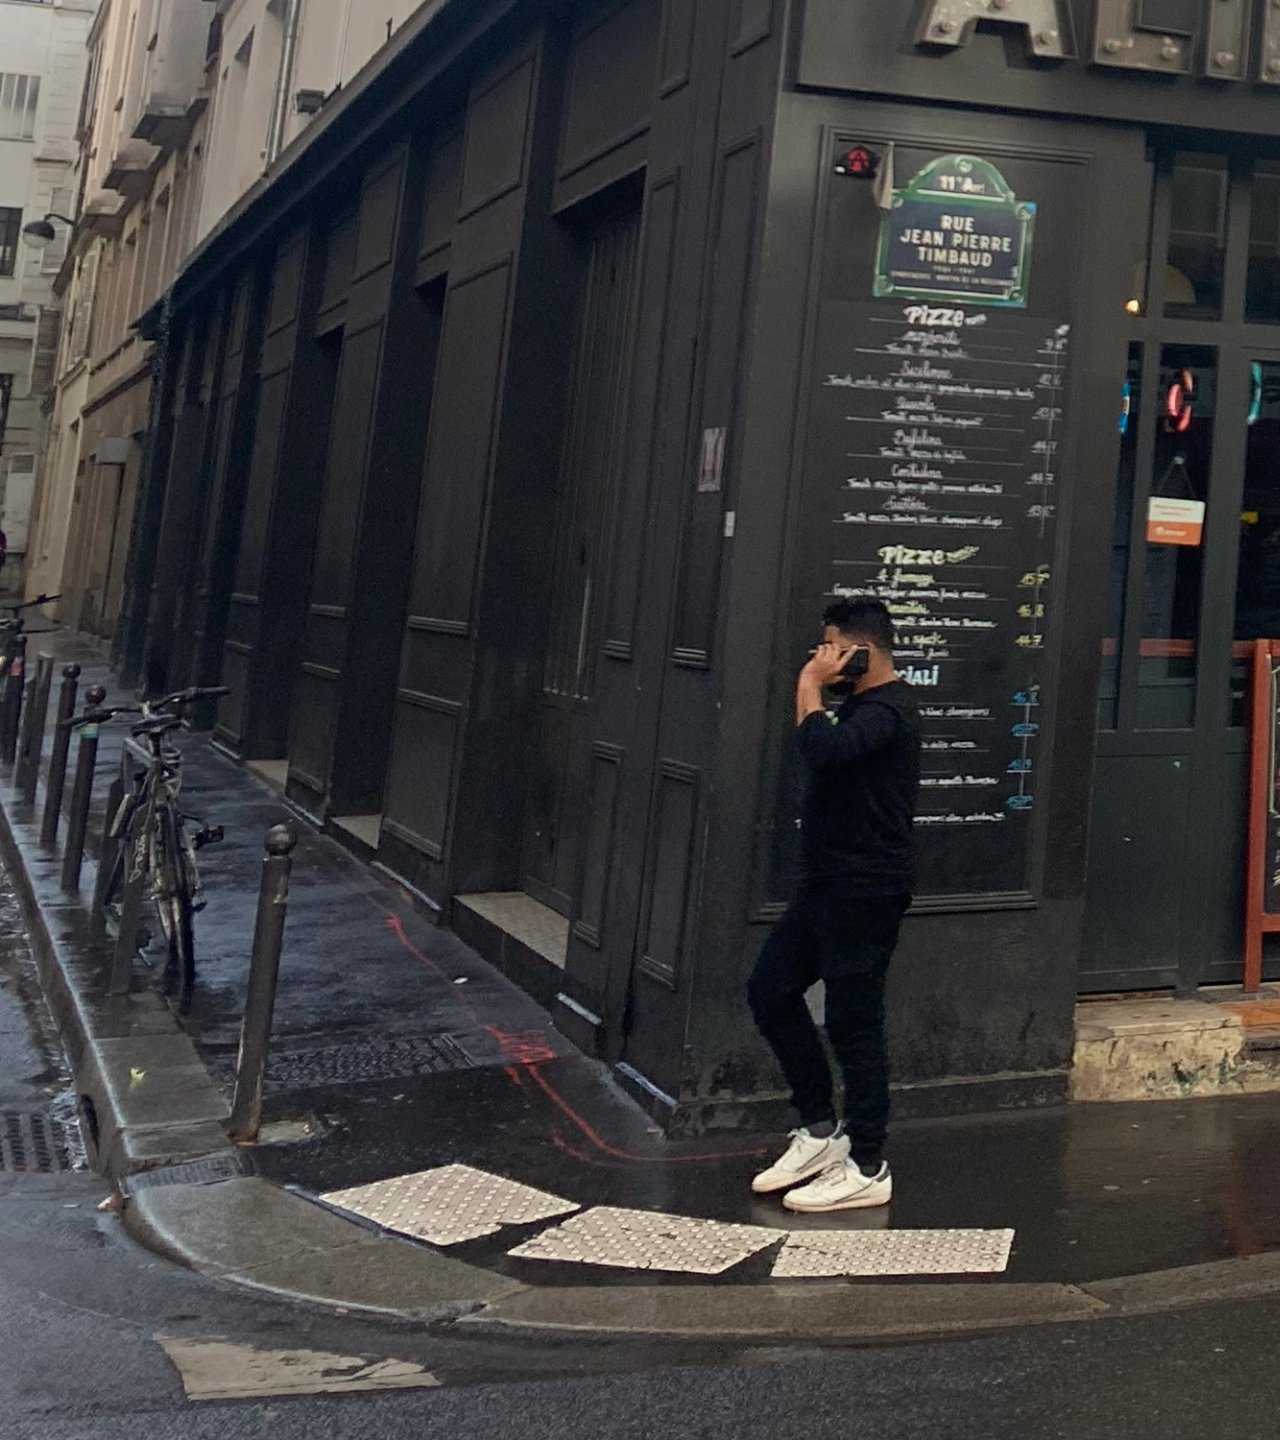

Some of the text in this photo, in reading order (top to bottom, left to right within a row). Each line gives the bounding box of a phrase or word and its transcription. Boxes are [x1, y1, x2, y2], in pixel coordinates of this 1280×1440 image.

[941, 214, 975, 232] RUE
[900, 229, 1012, 252] JEAN PIERRE
[918, 246, 993, 267] TIMBAUD
